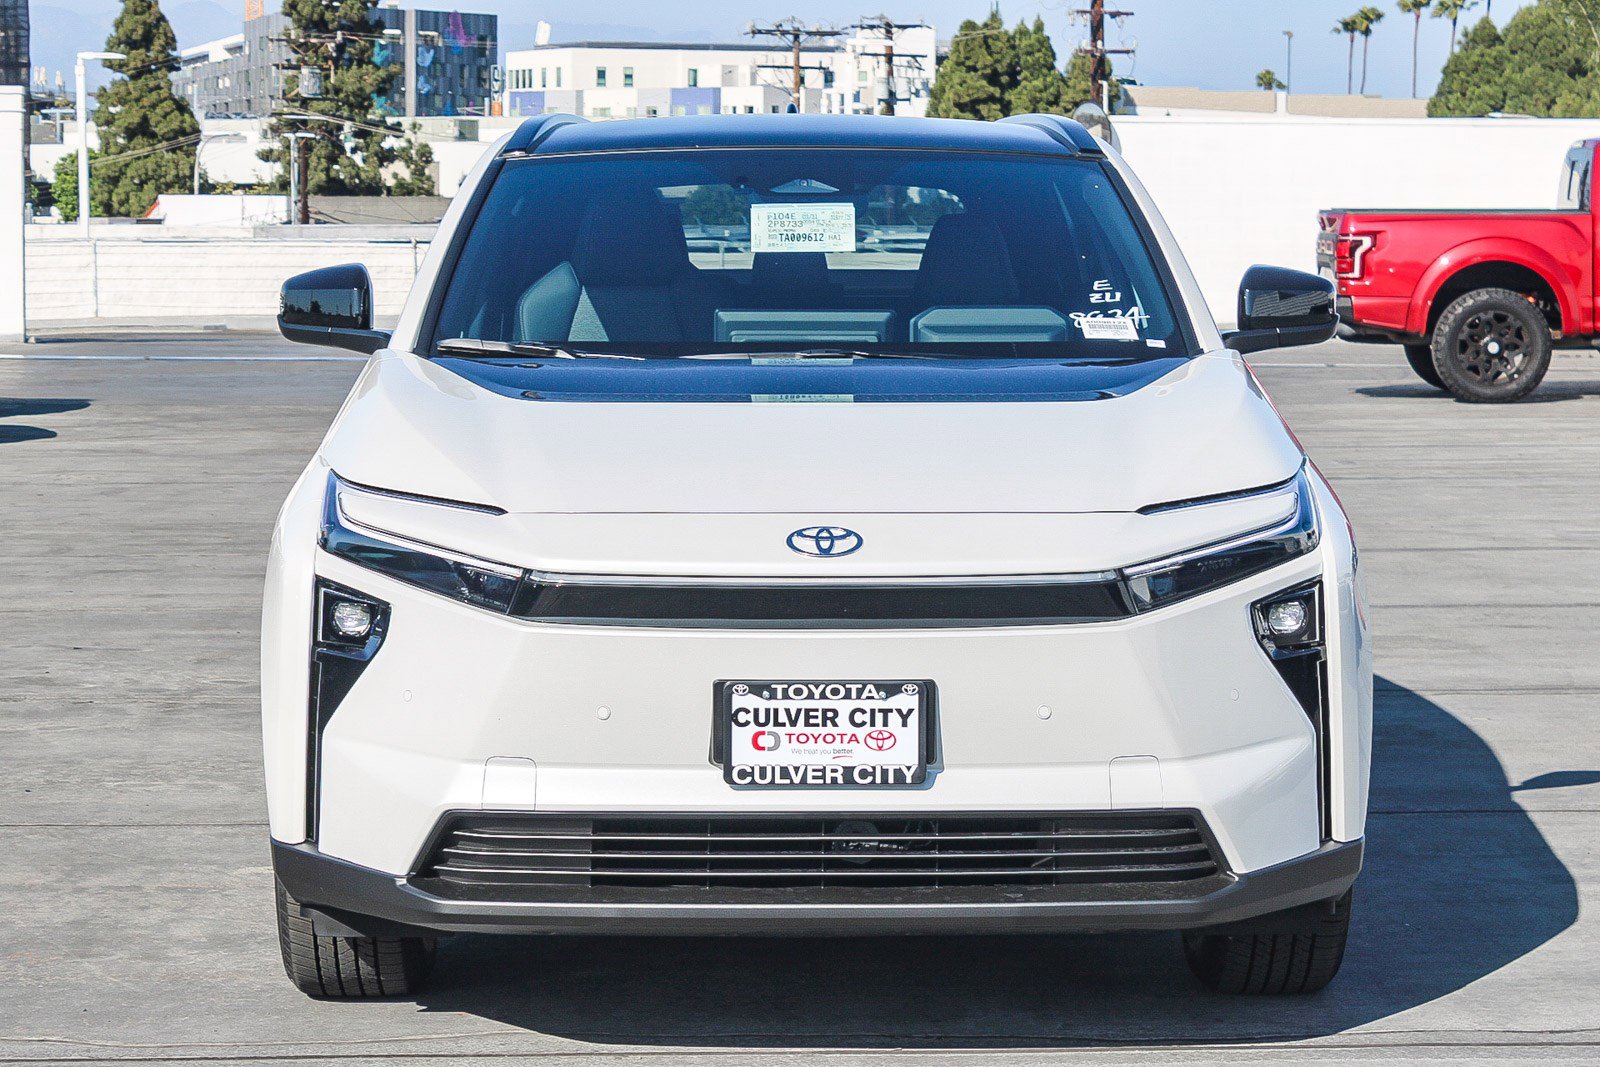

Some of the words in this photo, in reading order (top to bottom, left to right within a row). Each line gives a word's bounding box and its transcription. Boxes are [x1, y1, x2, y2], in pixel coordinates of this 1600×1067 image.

[778, 233, 825, 242] TA009612
[771, 683, 880, 700] TOYOTA
[731, 707, 840, 728] CULVER
[848, 707, 915, 728] CITY
[785, 733, 861, 745] TOYOTA
[731, 764, 844, 785] CULVER
[852, 764, 919, 785] CITY
